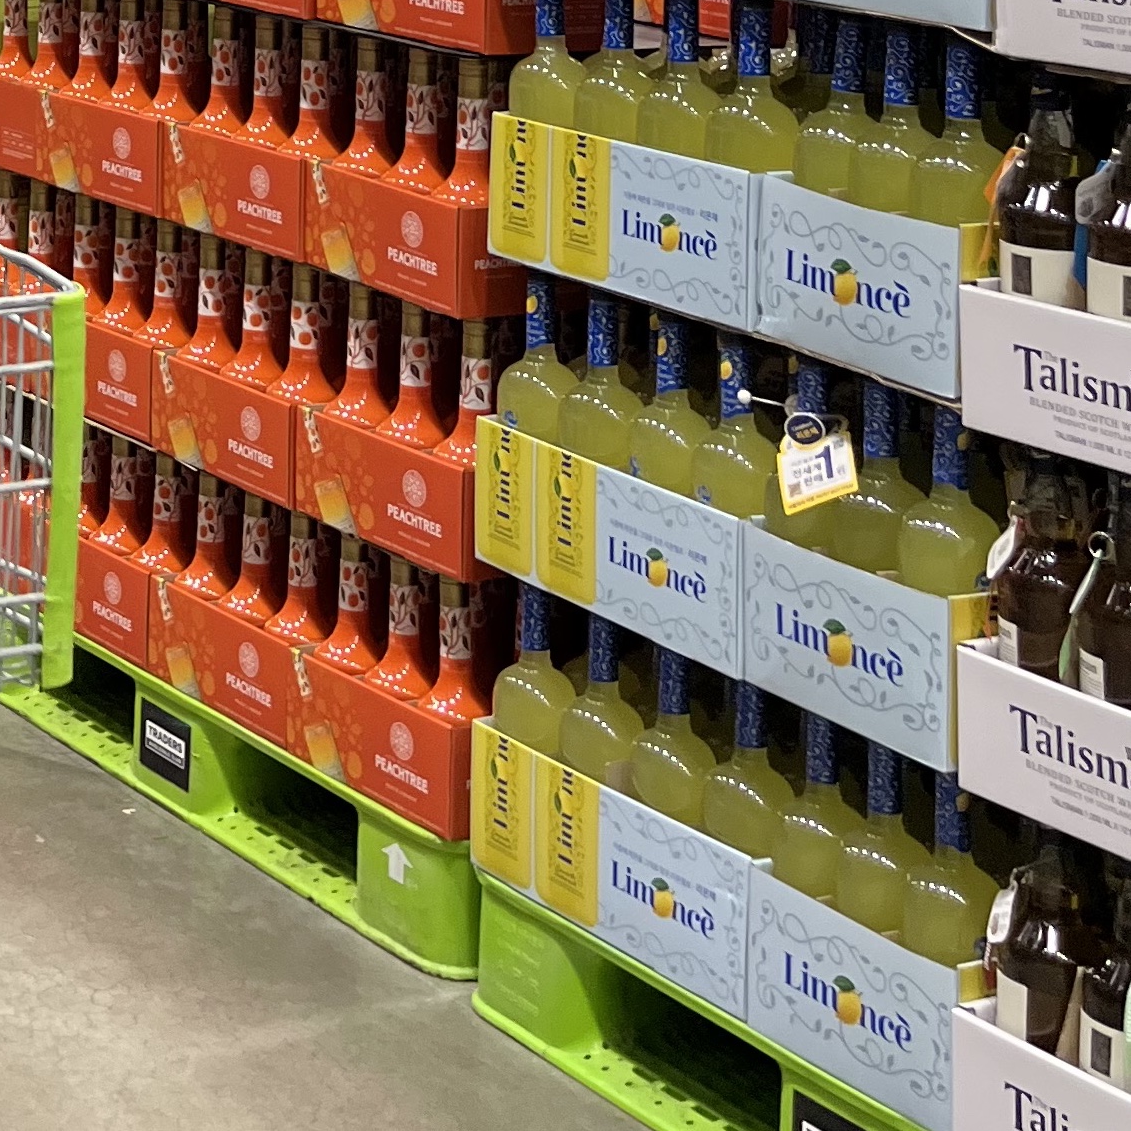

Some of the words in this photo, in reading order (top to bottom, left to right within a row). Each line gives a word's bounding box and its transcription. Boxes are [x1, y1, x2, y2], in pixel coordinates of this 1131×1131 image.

[1057, 8, 1104, 22] BLENDED
[101, 160, 143, 183] PEACHTREE
[236, 199, 283, 225] PEACHTREE
[387, 246, 439, 277] PEACHTREE
[97, 380, 138, 407] PEACHTREE
[1013, 344, 1131, 412] Talism
[227, 438, 274, 469] PEACHTREE
[387, 503, 442, 538] PEACHTREE
[92, 600, 133, 633] PEACHTREE
[225, 672, 272, 708] PEACHTREE
[148, 725, 183, 754] TRADERS
[1009, 704, 1131, 790] Talism
[374, 754, 429, 795] PEACHTREE
